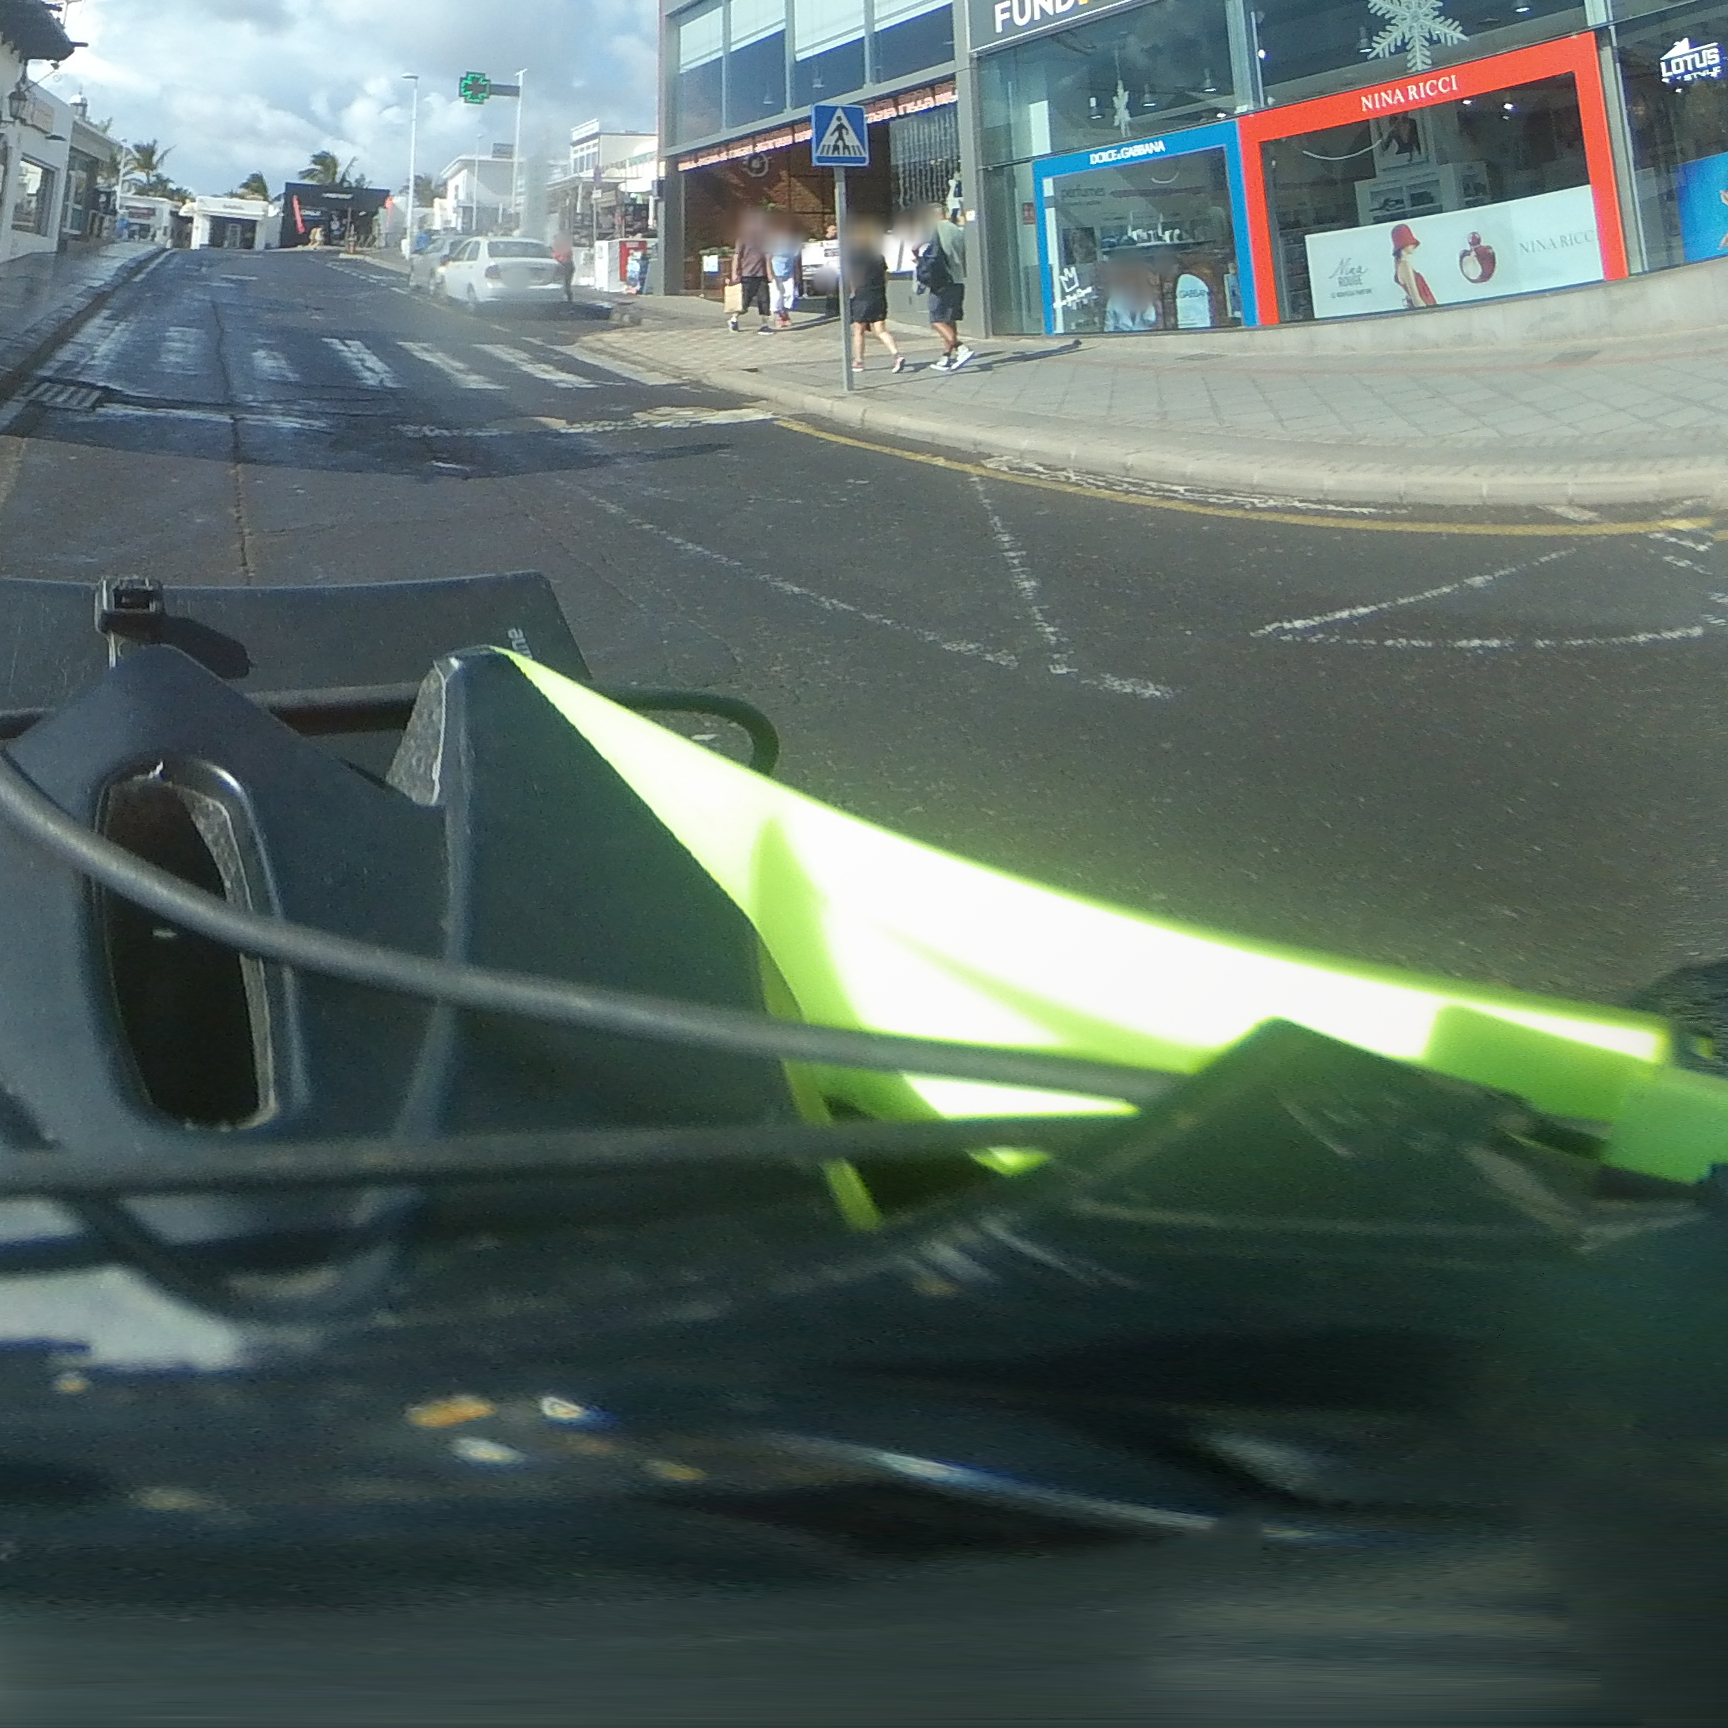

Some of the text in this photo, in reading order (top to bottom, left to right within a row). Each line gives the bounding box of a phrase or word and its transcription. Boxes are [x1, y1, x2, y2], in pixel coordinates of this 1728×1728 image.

[1660, 48, 1721, 78] LOTUS
[1360, 75, 1458, 112] NINA RICCI
[1519, 237, 1557, 255] NINA
